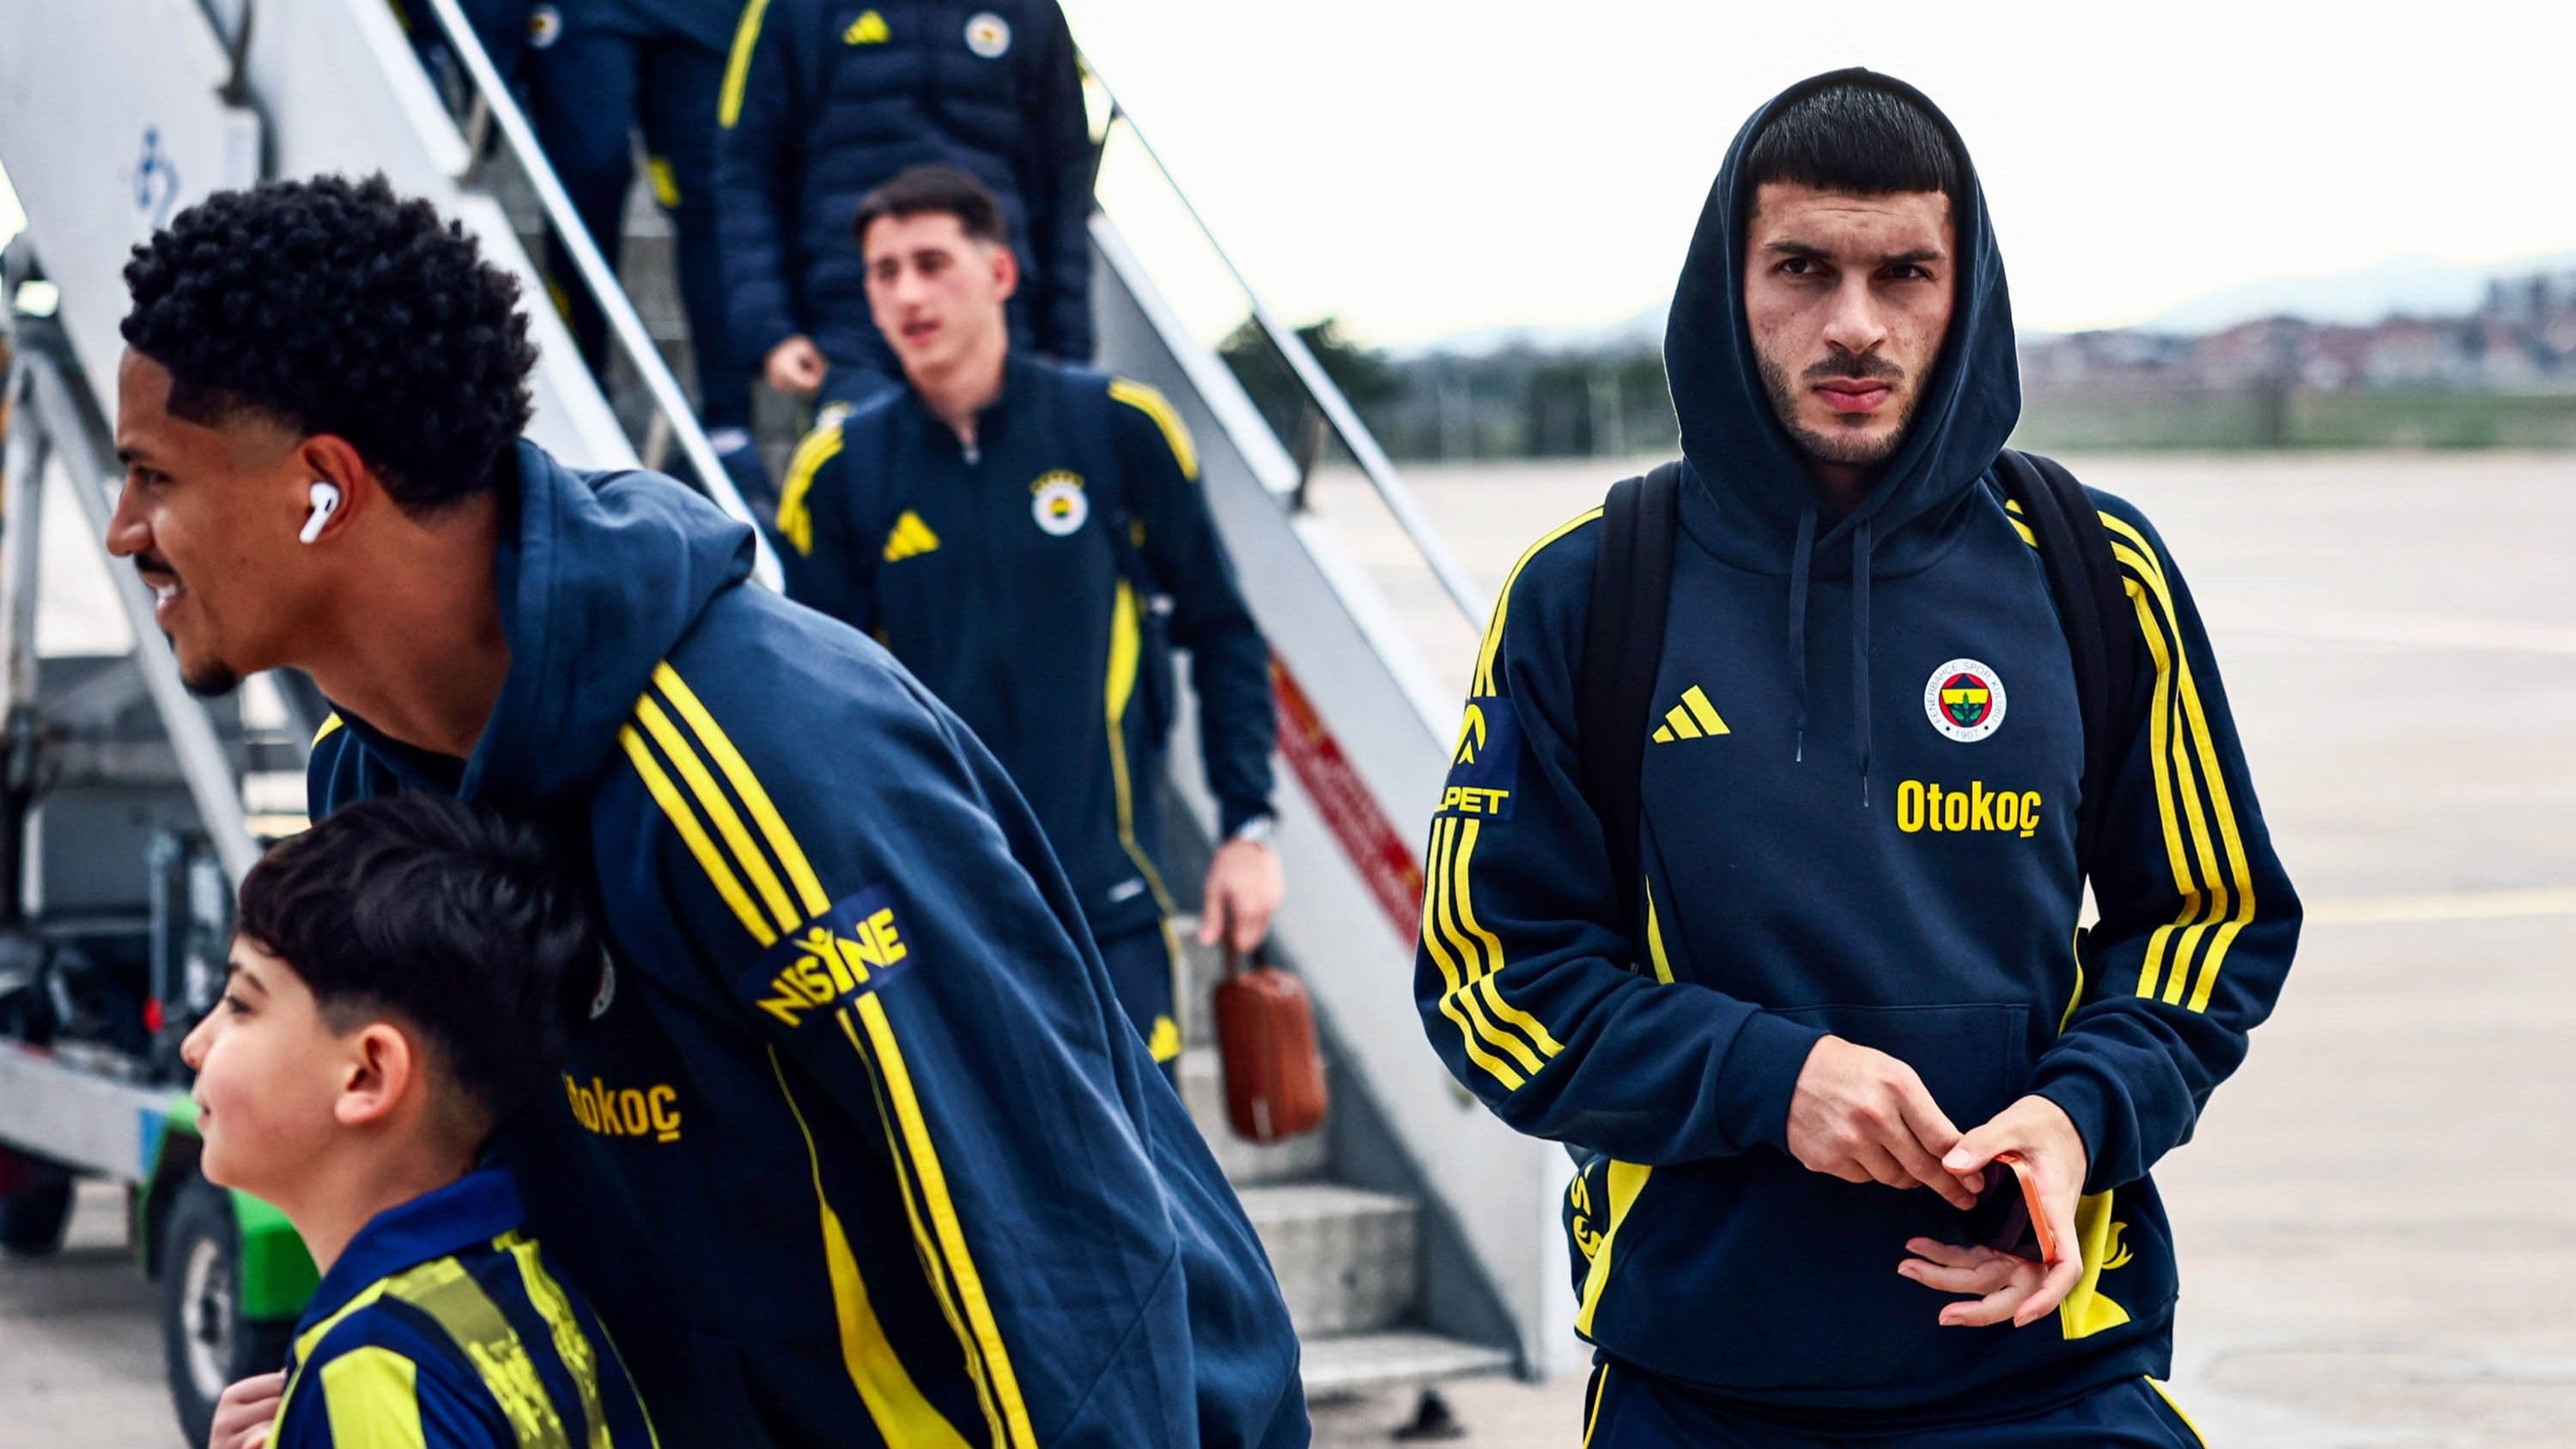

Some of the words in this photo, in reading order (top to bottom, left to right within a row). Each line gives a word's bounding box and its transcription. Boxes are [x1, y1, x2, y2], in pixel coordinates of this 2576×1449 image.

[1963, 661, 1992, 678] SPOR
[1435, 786, 1510, 815] PET
[1896, 779, 2042, 838] Otokoç
